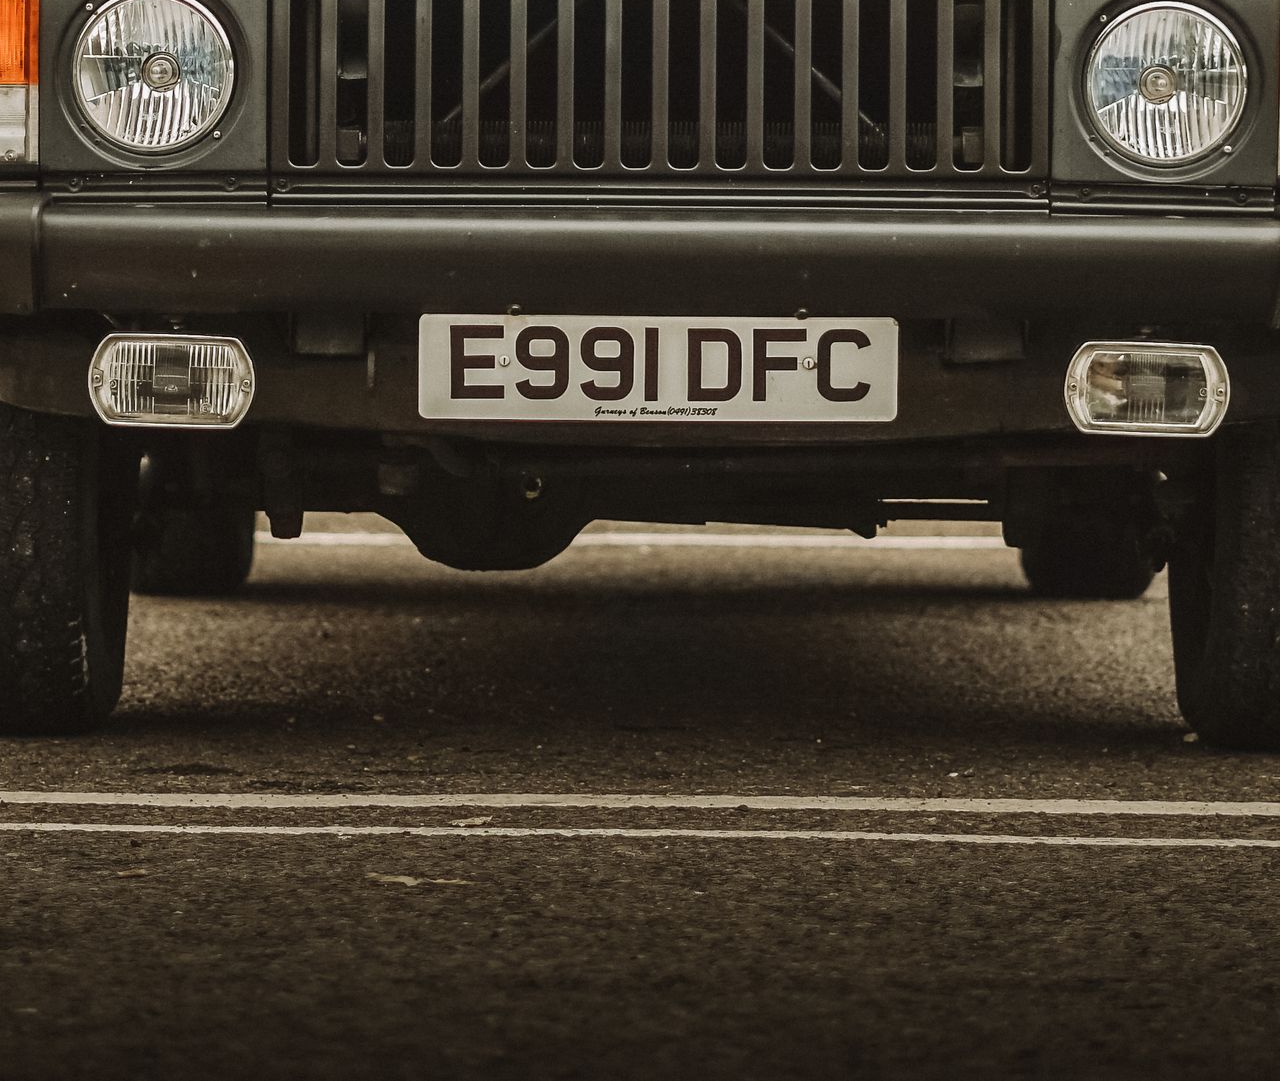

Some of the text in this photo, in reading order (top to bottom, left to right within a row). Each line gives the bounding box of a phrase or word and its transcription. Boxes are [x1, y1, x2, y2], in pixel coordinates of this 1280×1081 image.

[450, 324, 872, 402] E991 DFC
[629, 407, 638, 417] of
